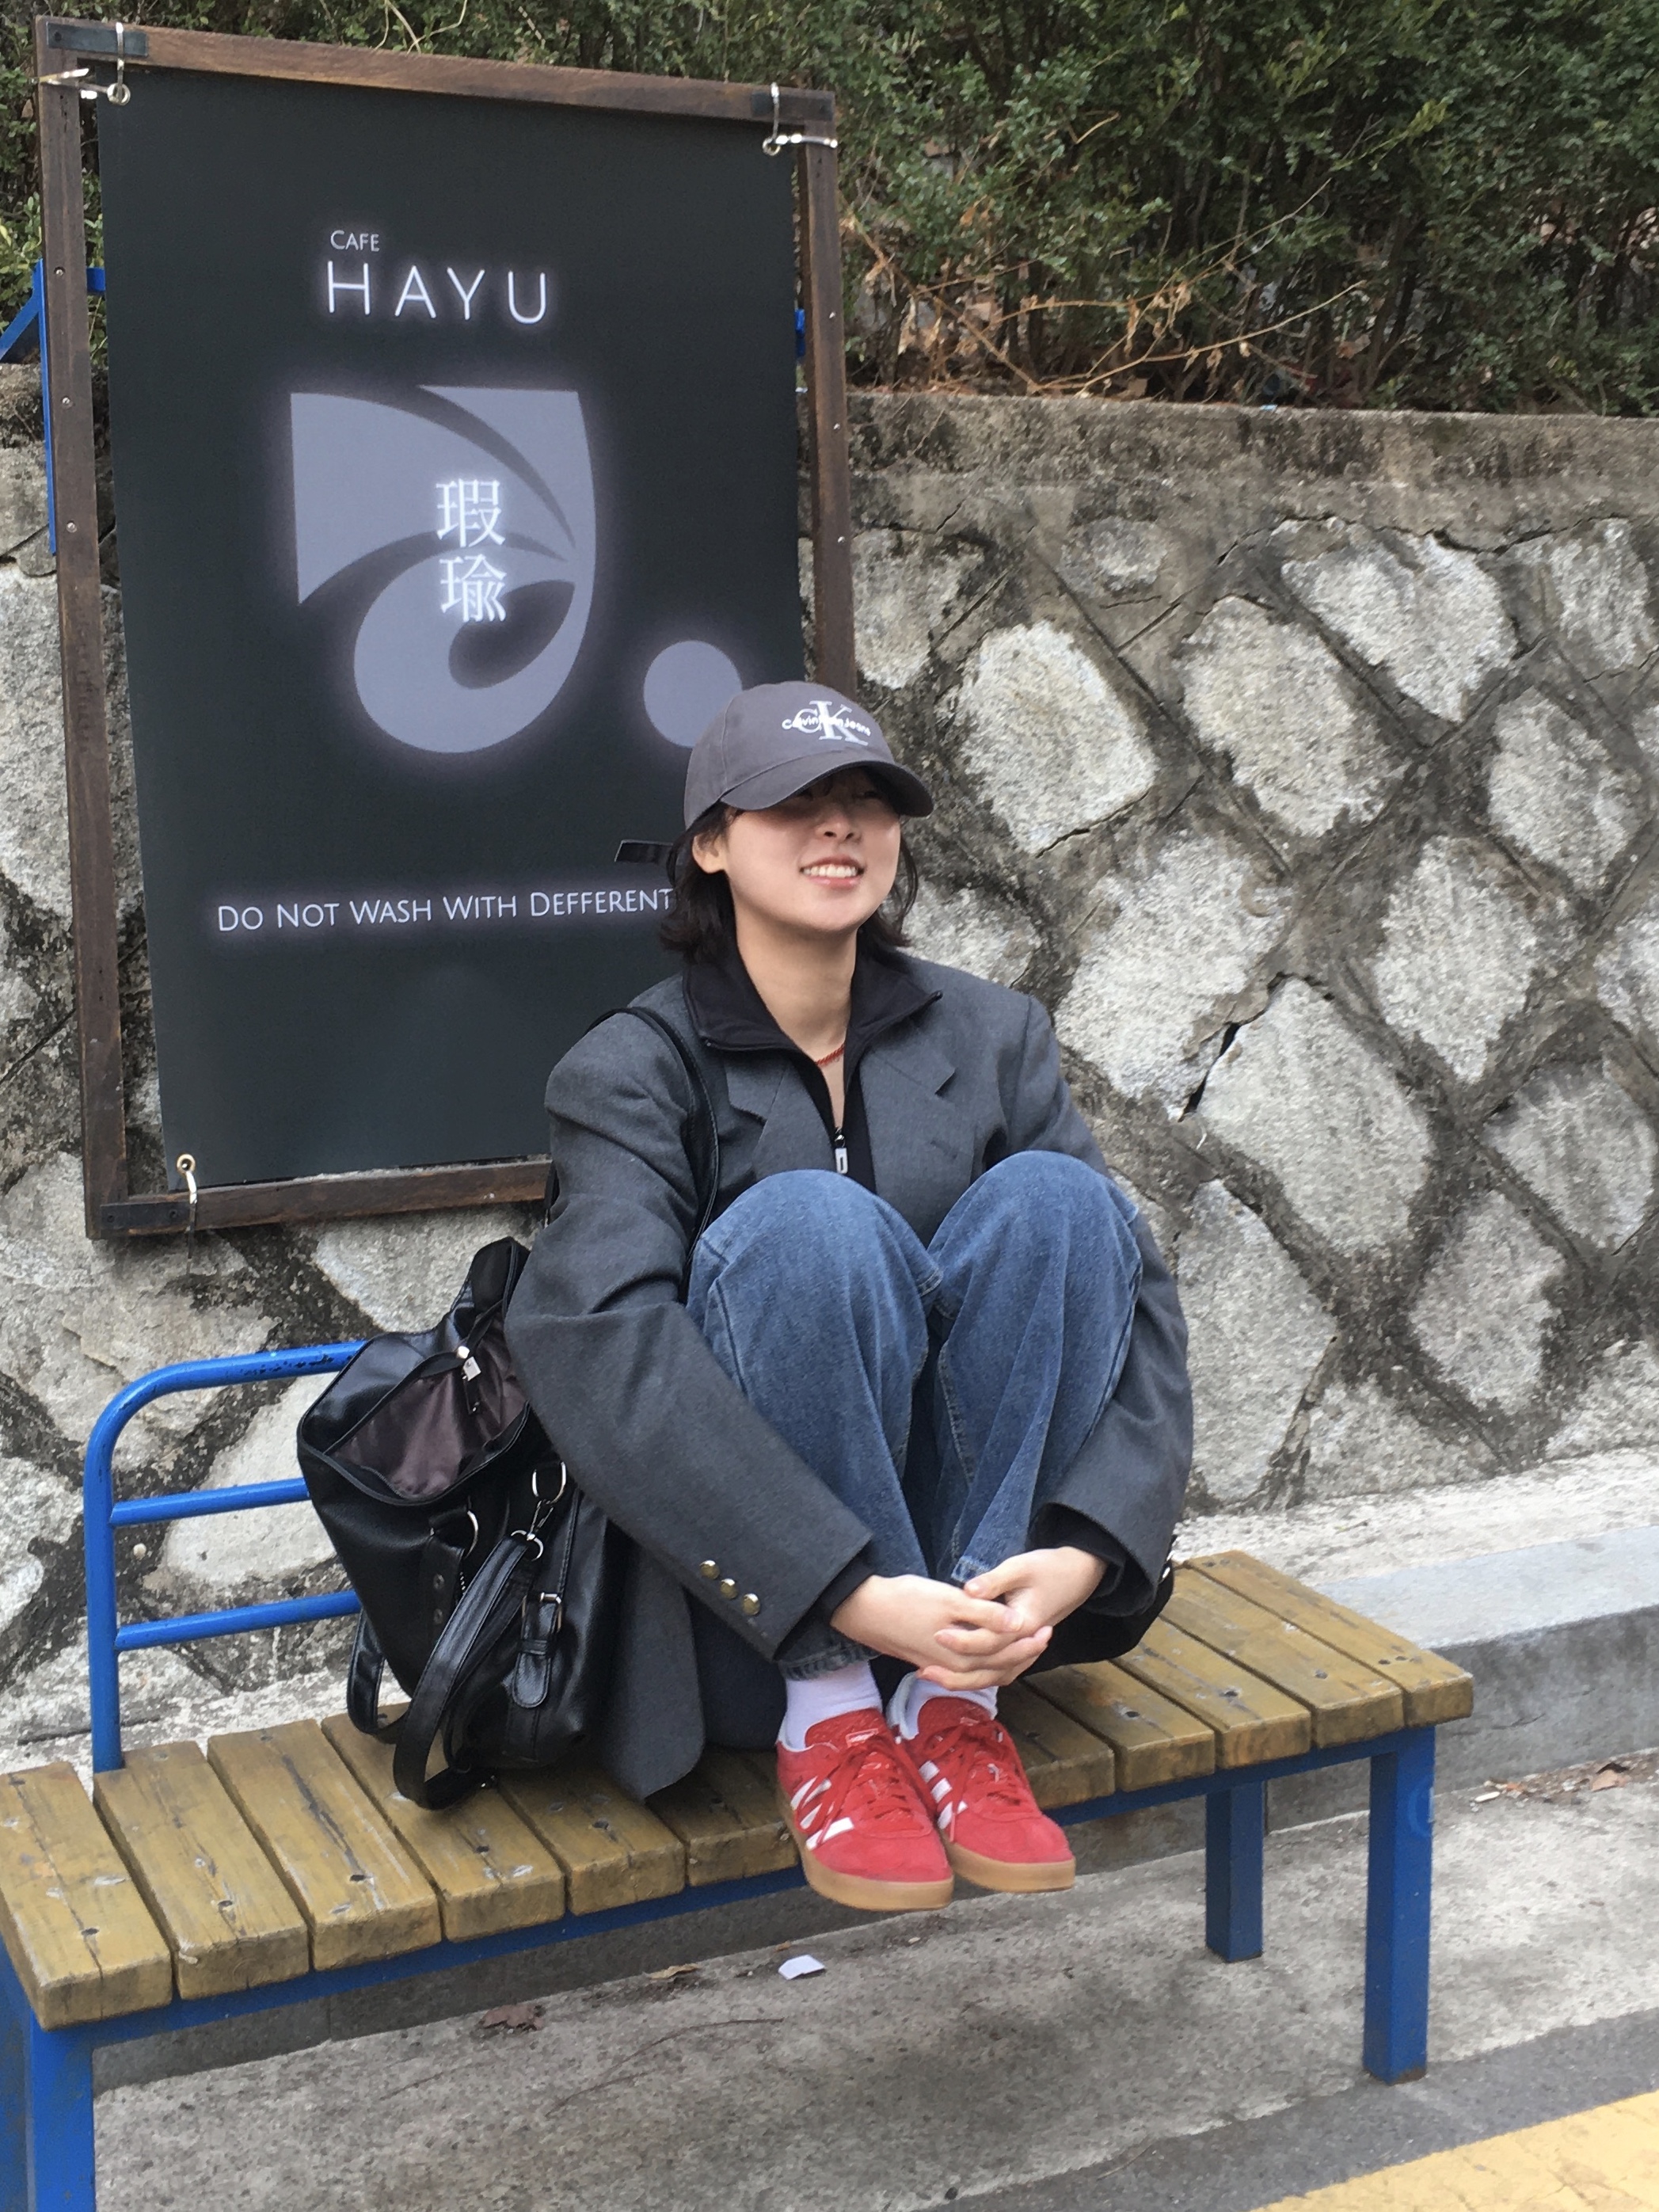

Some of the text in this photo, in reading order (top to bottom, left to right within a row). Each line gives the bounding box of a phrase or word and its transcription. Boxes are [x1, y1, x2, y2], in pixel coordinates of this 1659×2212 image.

[329, 229, 381, 253] CAFE
[327, 260, 547, 325] HAYU
[436, 478, 508, 623] 瑕瑜
[218, 888, 674, 931] DO NOT WASH WITH DEFFERENT
